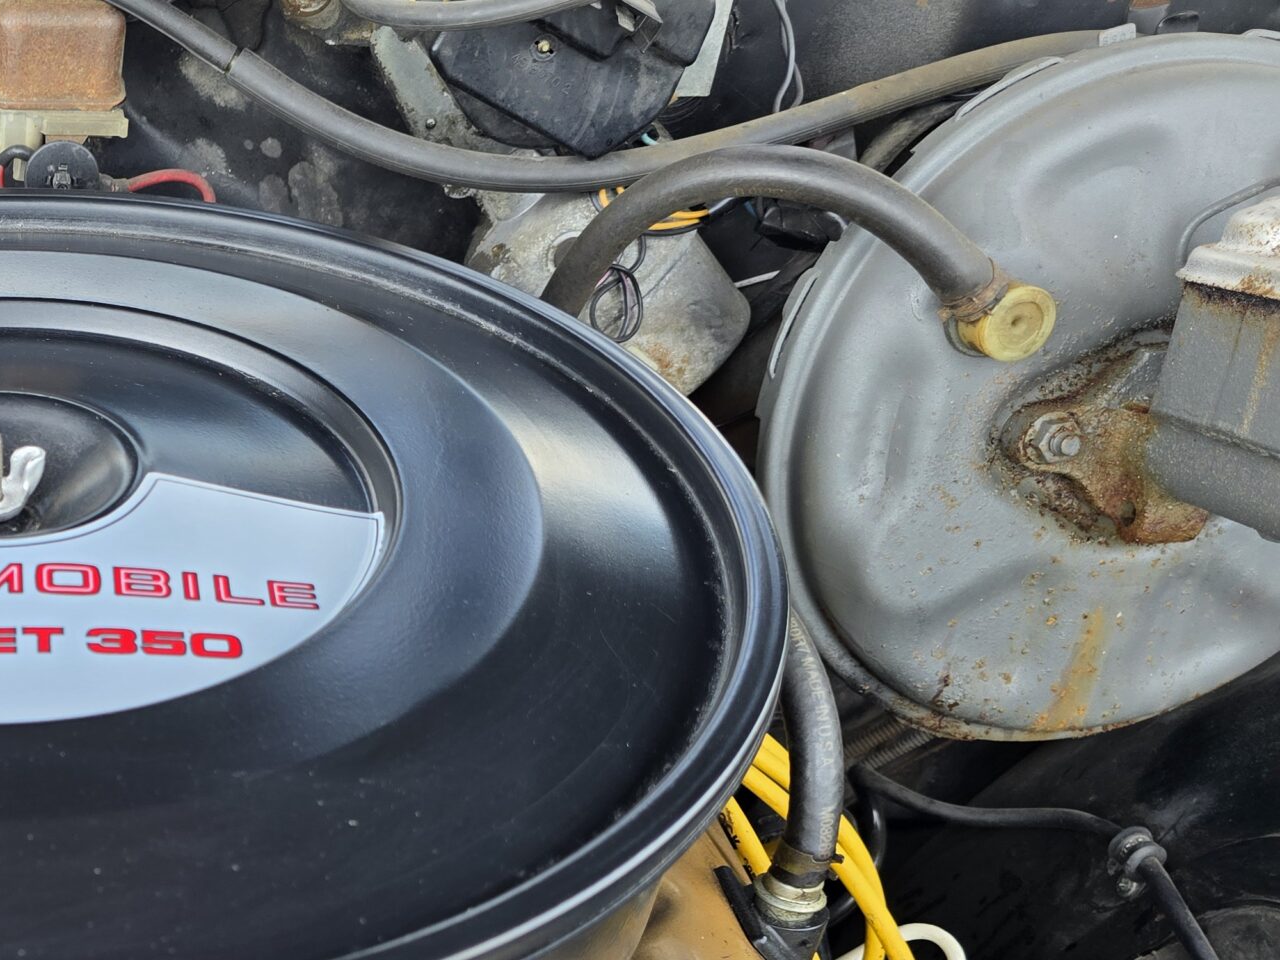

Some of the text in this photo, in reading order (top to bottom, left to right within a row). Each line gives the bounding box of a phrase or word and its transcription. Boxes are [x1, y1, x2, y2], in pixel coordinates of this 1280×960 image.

[86, 627, 243, 659] 350
[801, 656, 826, 699] MADE
[815, 704, 830, 720] IN
